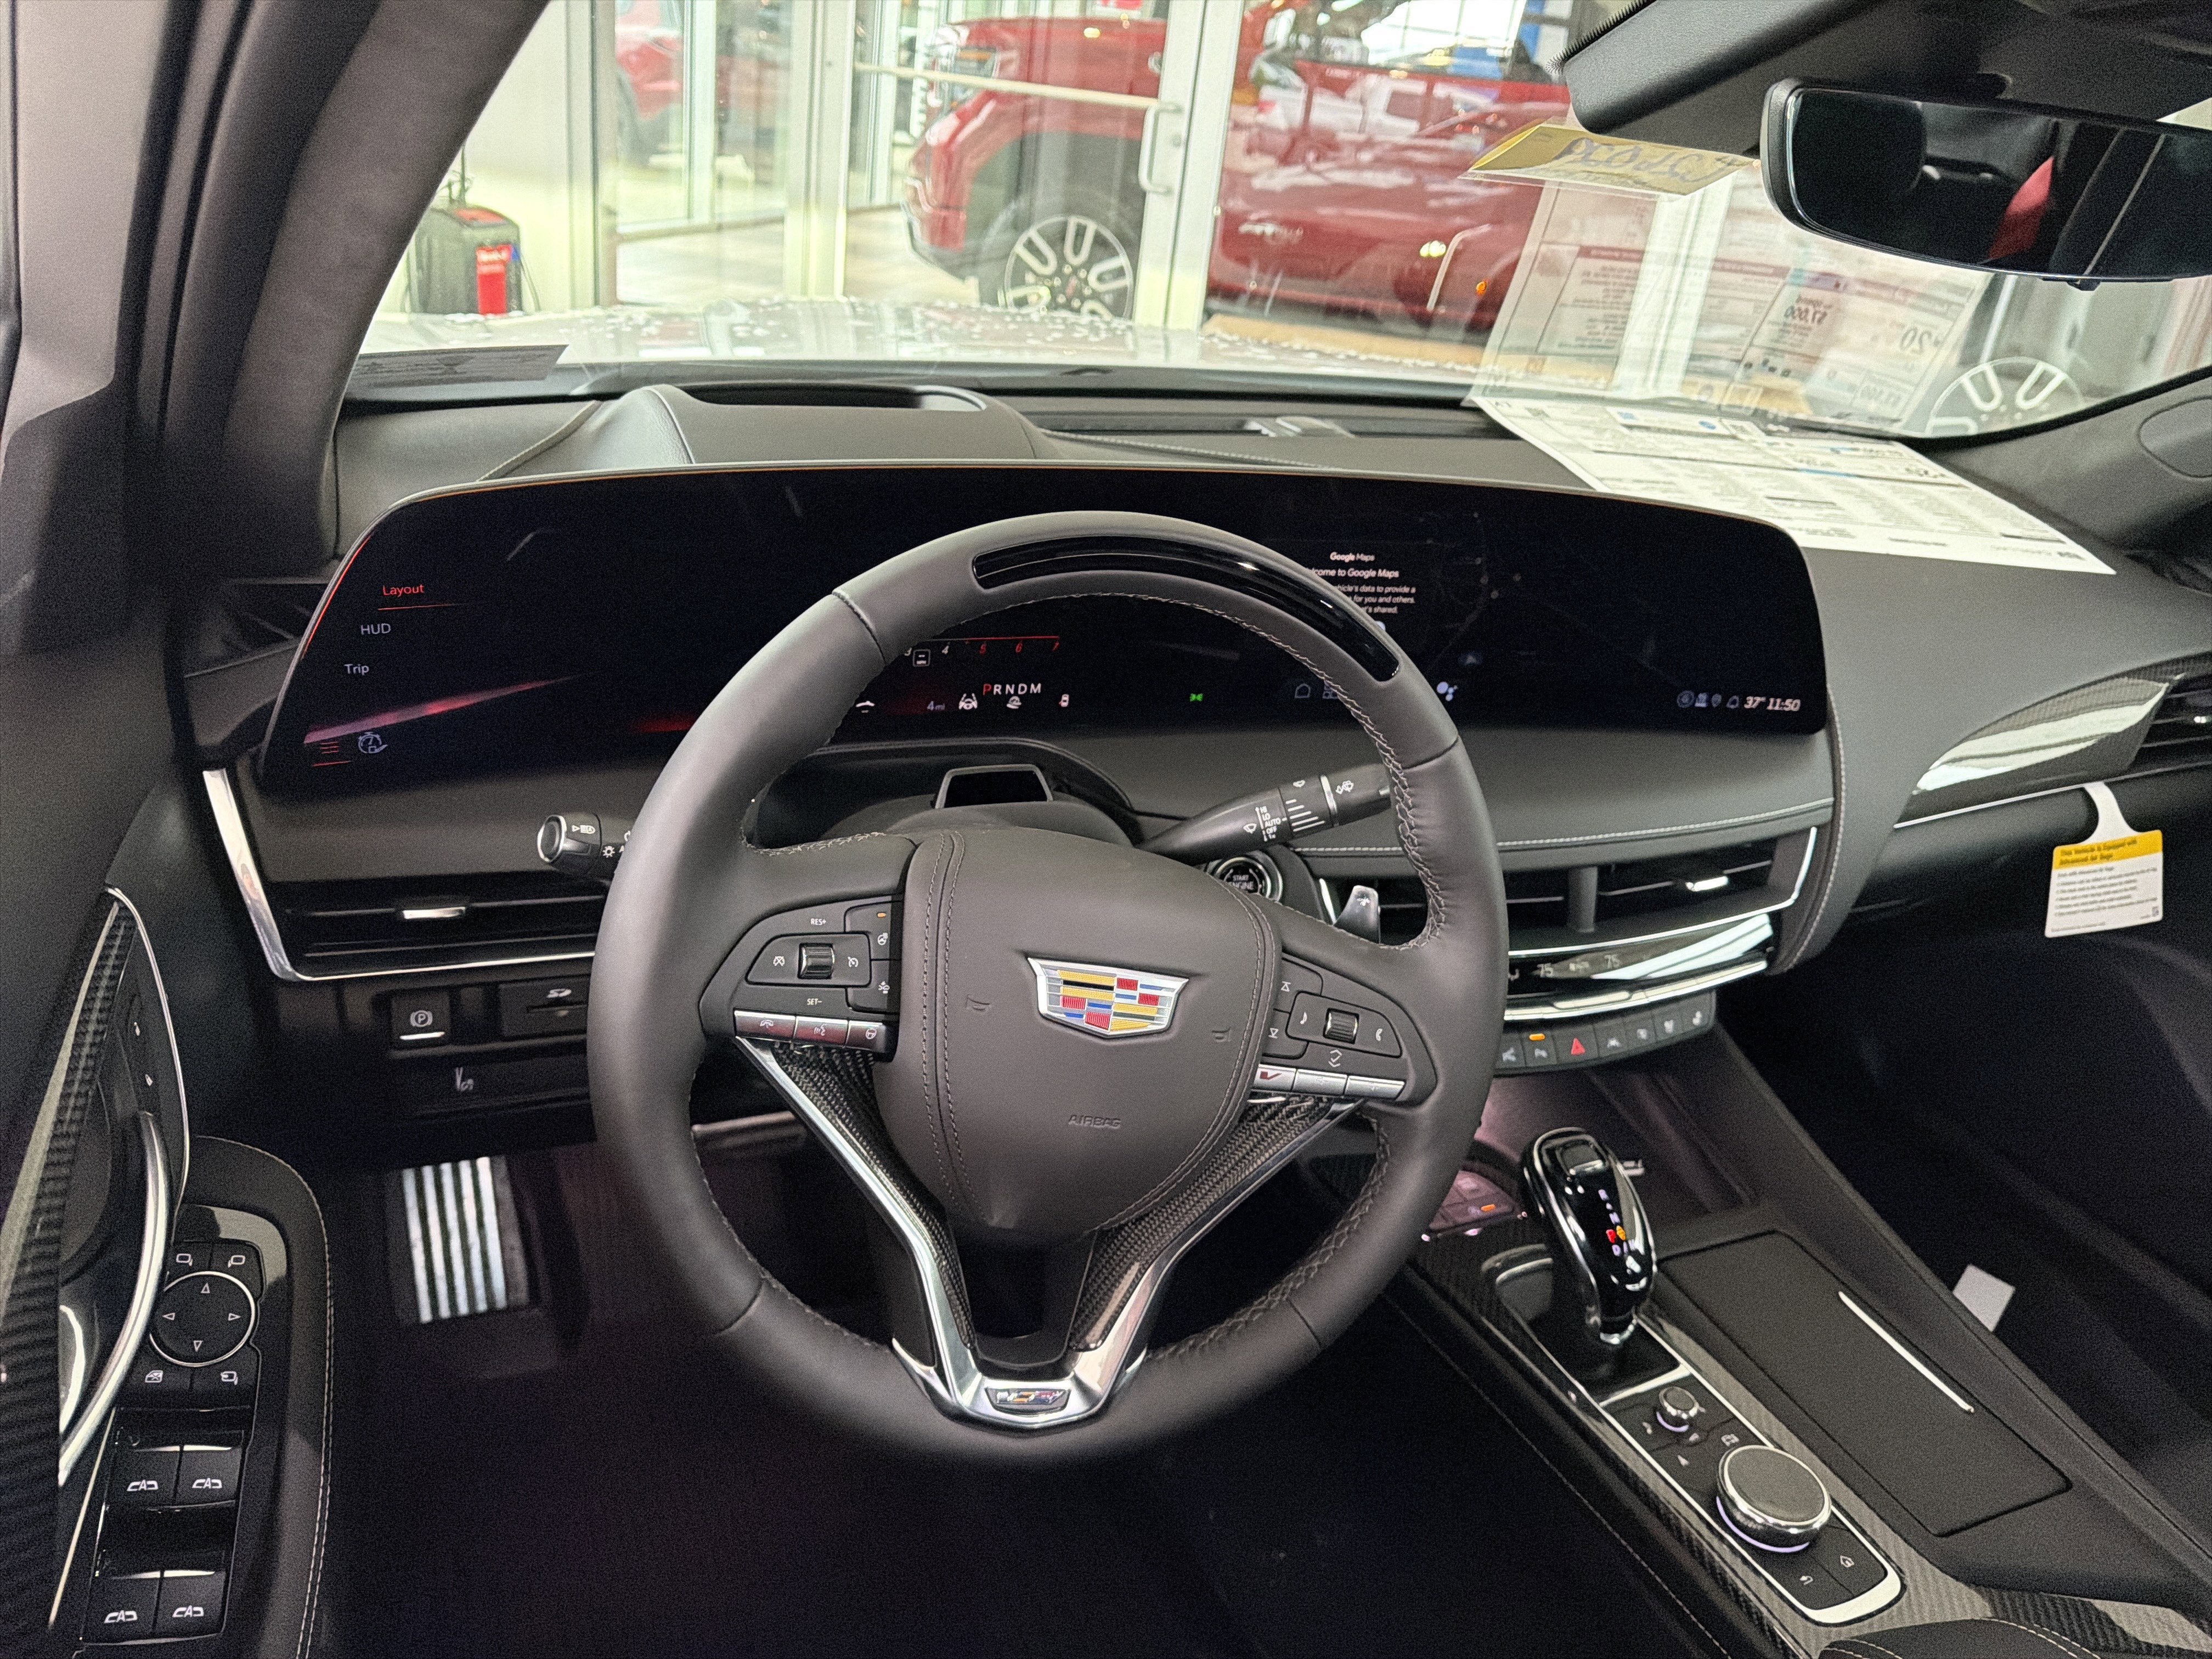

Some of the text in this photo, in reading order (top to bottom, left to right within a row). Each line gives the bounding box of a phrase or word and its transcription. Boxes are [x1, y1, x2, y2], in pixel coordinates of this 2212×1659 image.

[1330, 551, 1375, 563] Google Maps
[1337, 568, 1346, 577] to
[1347, 568, 1376, 579] Google
[1378, 569, 1400, 579] Maps
[382, 584, 425, 597] Layout
[1359, 584, 1376, 592] data
[1385, 585, 1410, 594] provide
[1353, 594, 1364, 603] for
[361, 623, 391, 635] HUD
[942, 645, 949, 654] 4
[1015, 642, 1023, 653] 6
[1052, 641, 1060, 652] 7
[344, 663, 369, 675] Trip
[1767, 697, 1801, 712] 11:50
[1262, 812, 1271, 821] LO
[1265, 817, 1282, 828] AUTO
[1266, 826, 1277, 834] OFF
[1537, 962, 1554, 978] 75
[1068, 1114, 1121, 1129] AIRBAG
